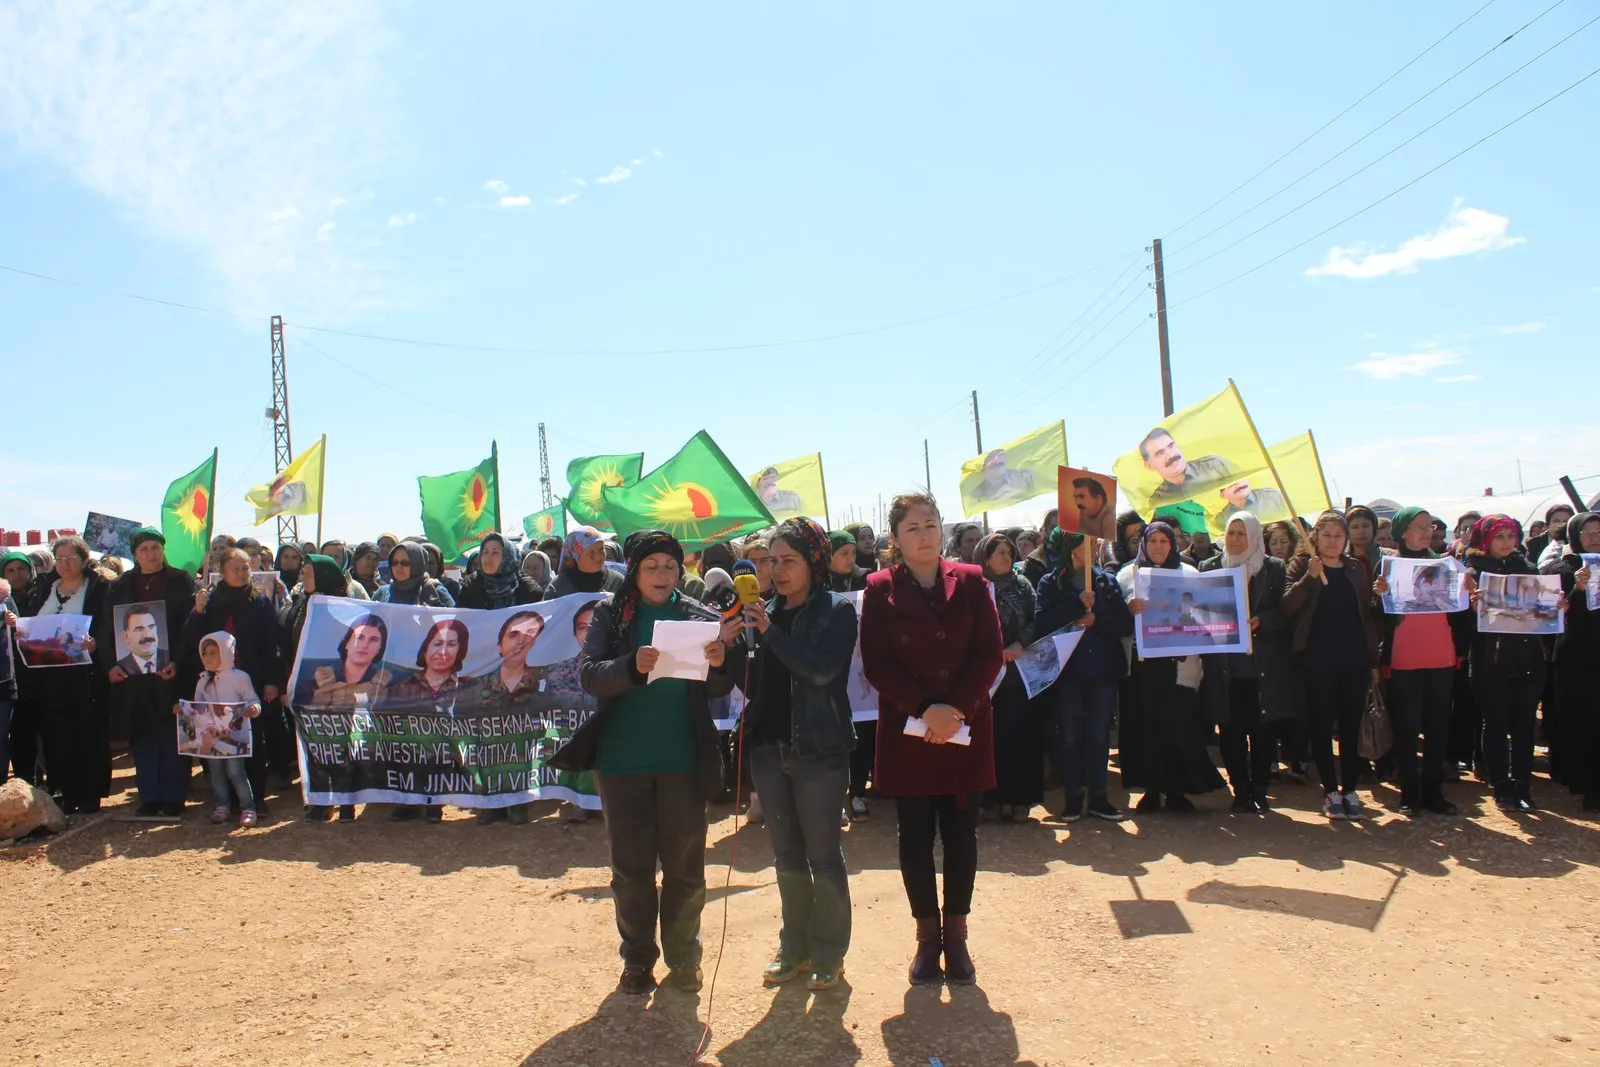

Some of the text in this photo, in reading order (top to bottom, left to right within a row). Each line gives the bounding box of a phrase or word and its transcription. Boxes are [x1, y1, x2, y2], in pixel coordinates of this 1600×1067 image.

[381, 715, 404, 735] ME
[540, 709, 562, 730] ME
[308, 742, 344, 765] RIHE
[348, 740, 370, 761] ME
[375, 740, 427, 765] AVESTA
[525, 737, 546, 763] ME
[387, 766, 559, 793] EM JININ LI VIRIN
